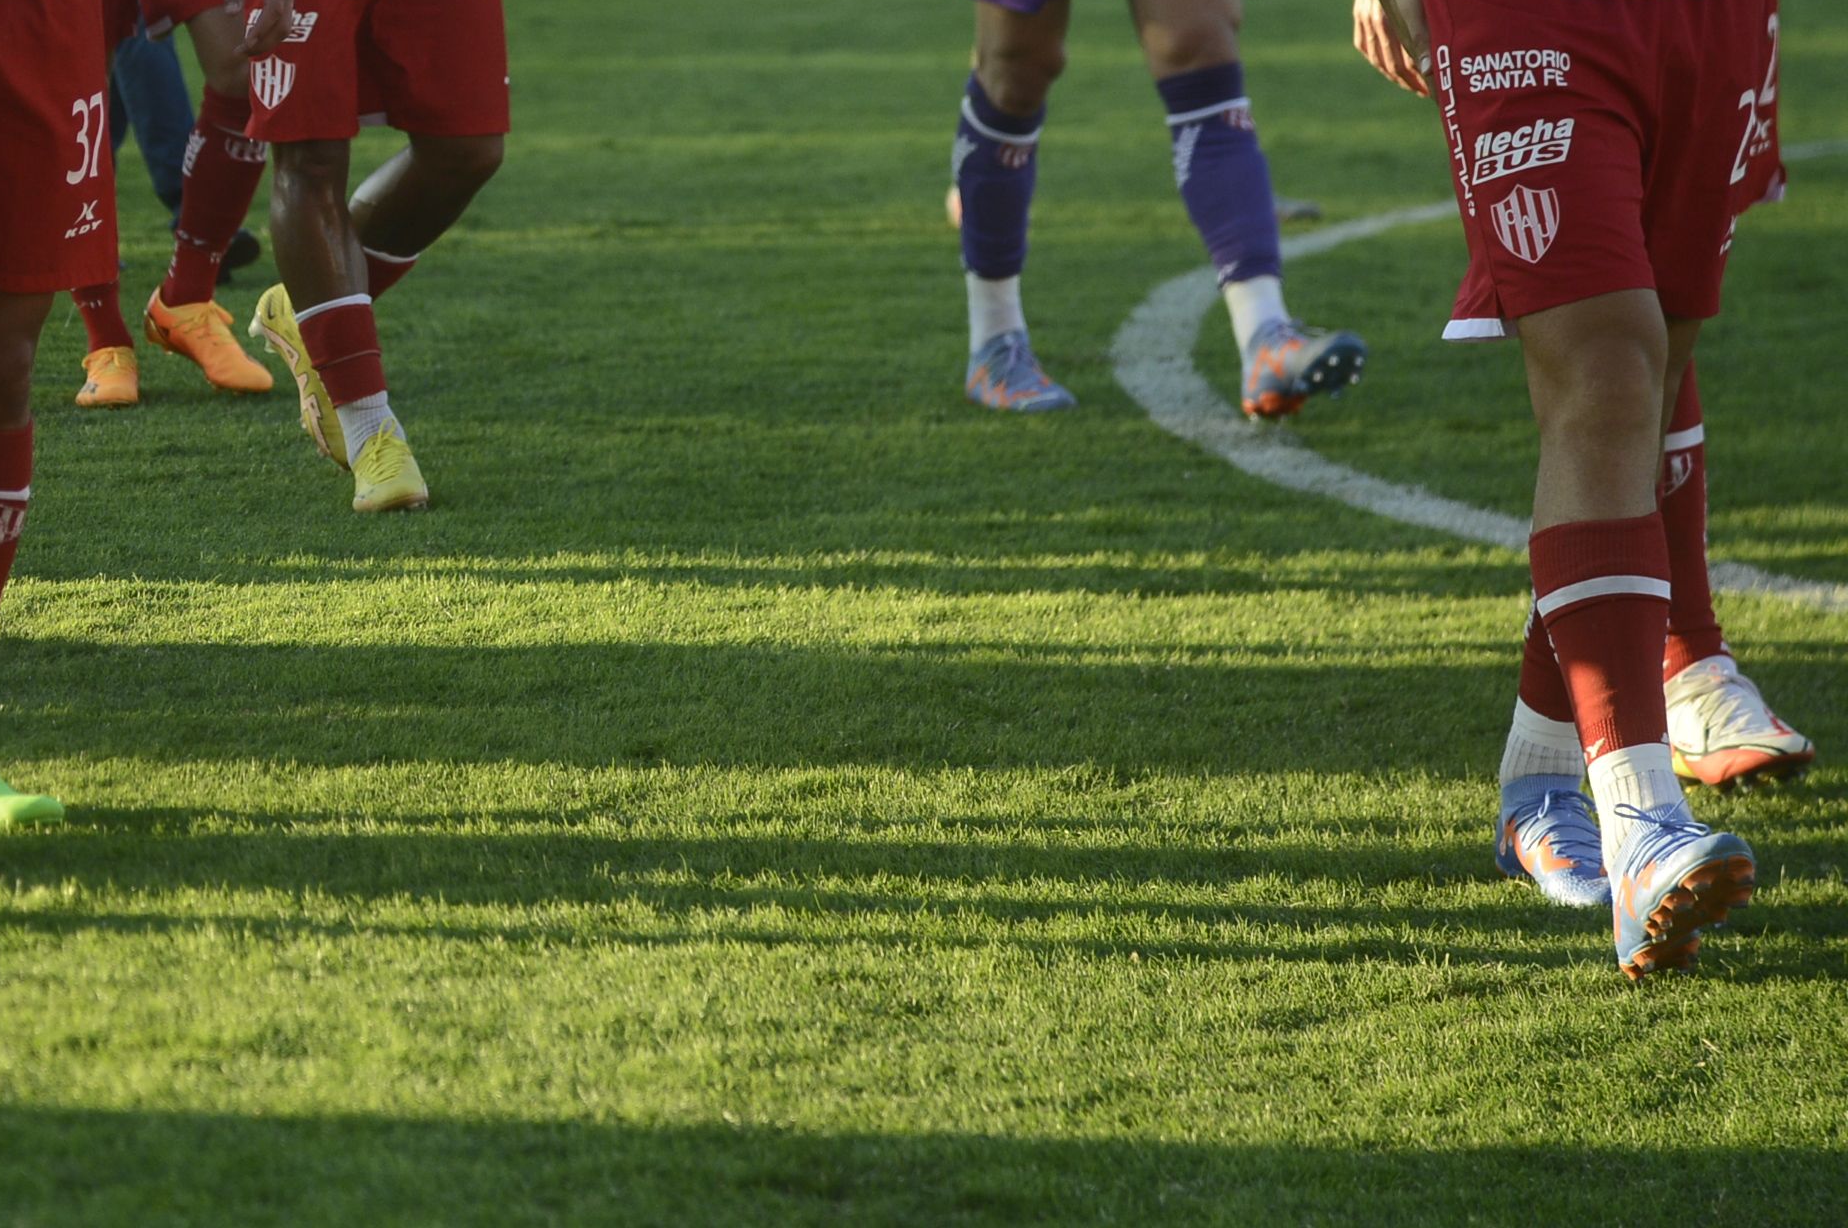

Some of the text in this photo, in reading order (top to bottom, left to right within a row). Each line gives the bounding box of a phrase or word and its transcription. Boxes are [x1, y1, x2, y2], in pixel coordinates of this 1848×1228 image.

[1460, 49, 1570, 76] SANATORIO
[1469, 69, 1568, 93] SANTA FE
[66, 91, 105, 185] 37
[1474, 117, 1575, 160] flecha
[1476, 140, 1567, 183] BUS
[65, 220, 103, 239] KDY
